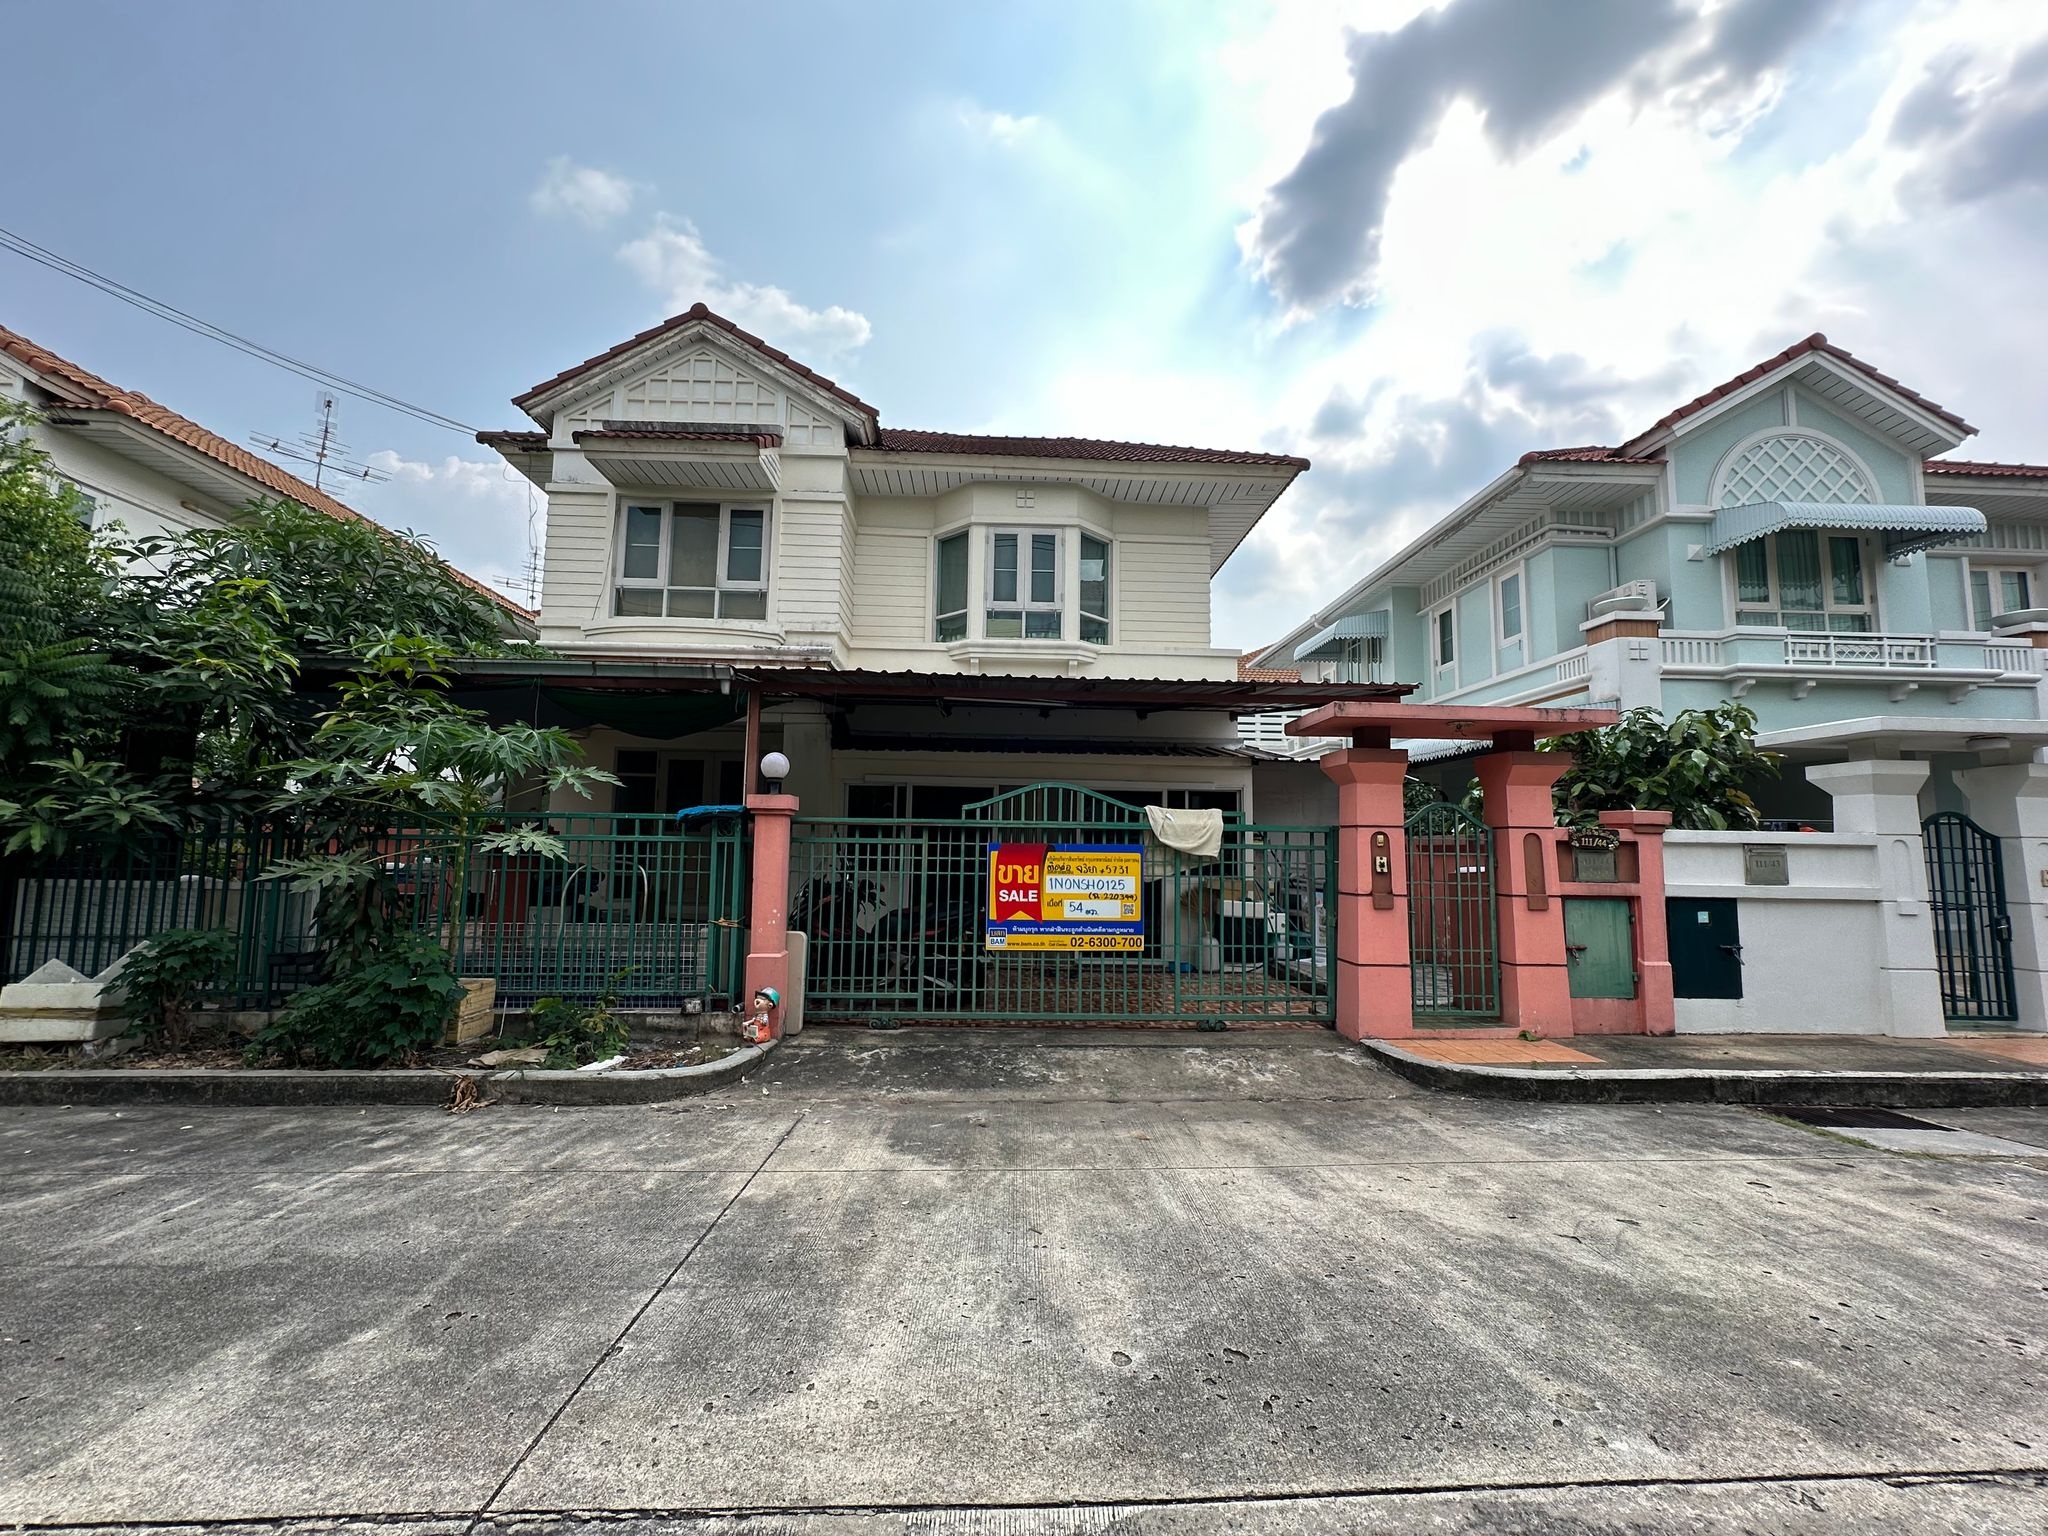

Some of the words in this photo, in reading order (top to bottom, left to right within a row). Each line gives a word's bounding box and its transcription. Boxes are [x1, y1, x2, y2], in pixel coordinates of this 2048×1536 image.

[1581, 837, 1607, 847] 111/44
[998, 864, 1039, 884] ขาย
[999, 889, 1038, 902] SALE
[1047, 898, 1063, 907] เนื้อที่
[1069, 901, 1083, 913] 54
[1070, 937, 1143, 948] 02-6300-700
